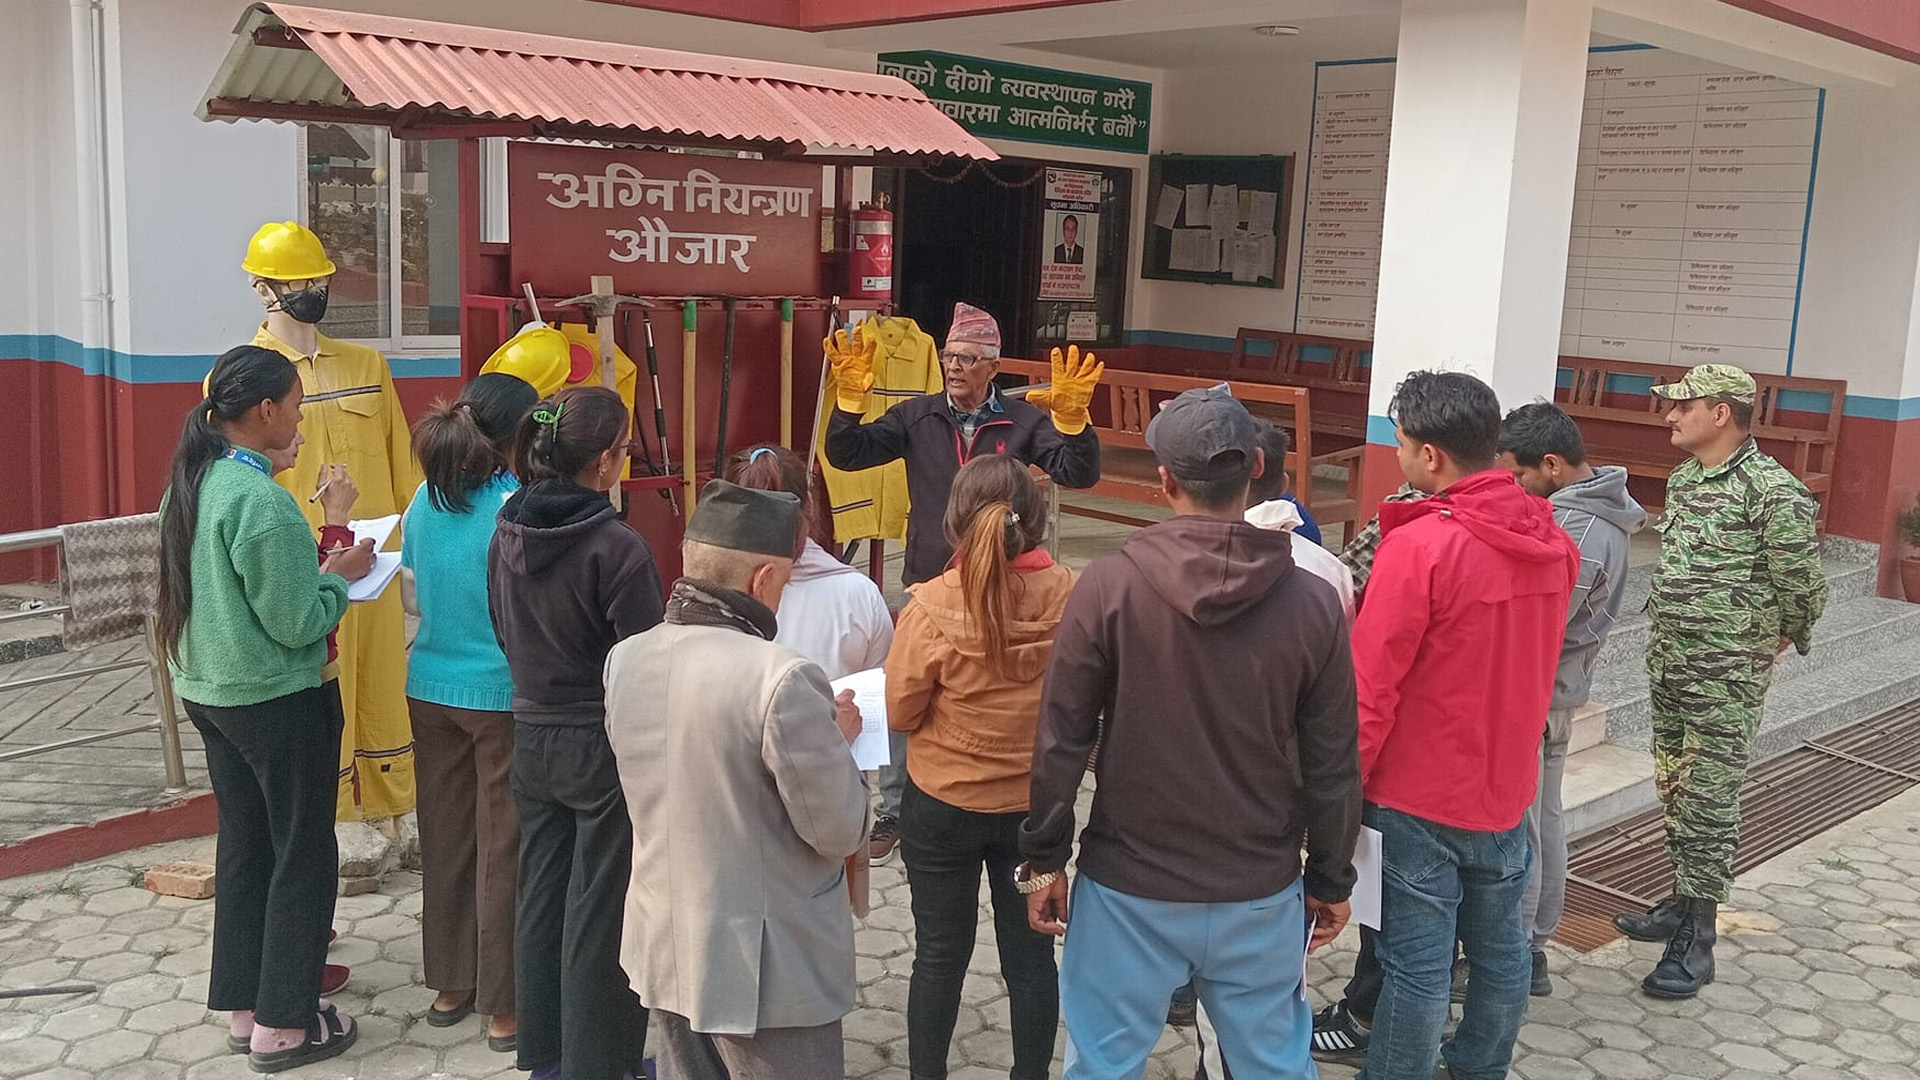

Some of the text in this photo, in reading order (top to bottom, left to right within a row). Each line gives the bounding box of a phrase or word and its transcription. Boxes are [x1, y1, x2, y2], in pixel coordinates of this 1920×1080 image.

[945, 64, 995, 94] दीगो
[1007, 105, 1098, 136] आत्मनिर्भर
[537, 162, 814, 217] अग्नि नियन्त्रण
[605, 216, 757, 274] औजार
